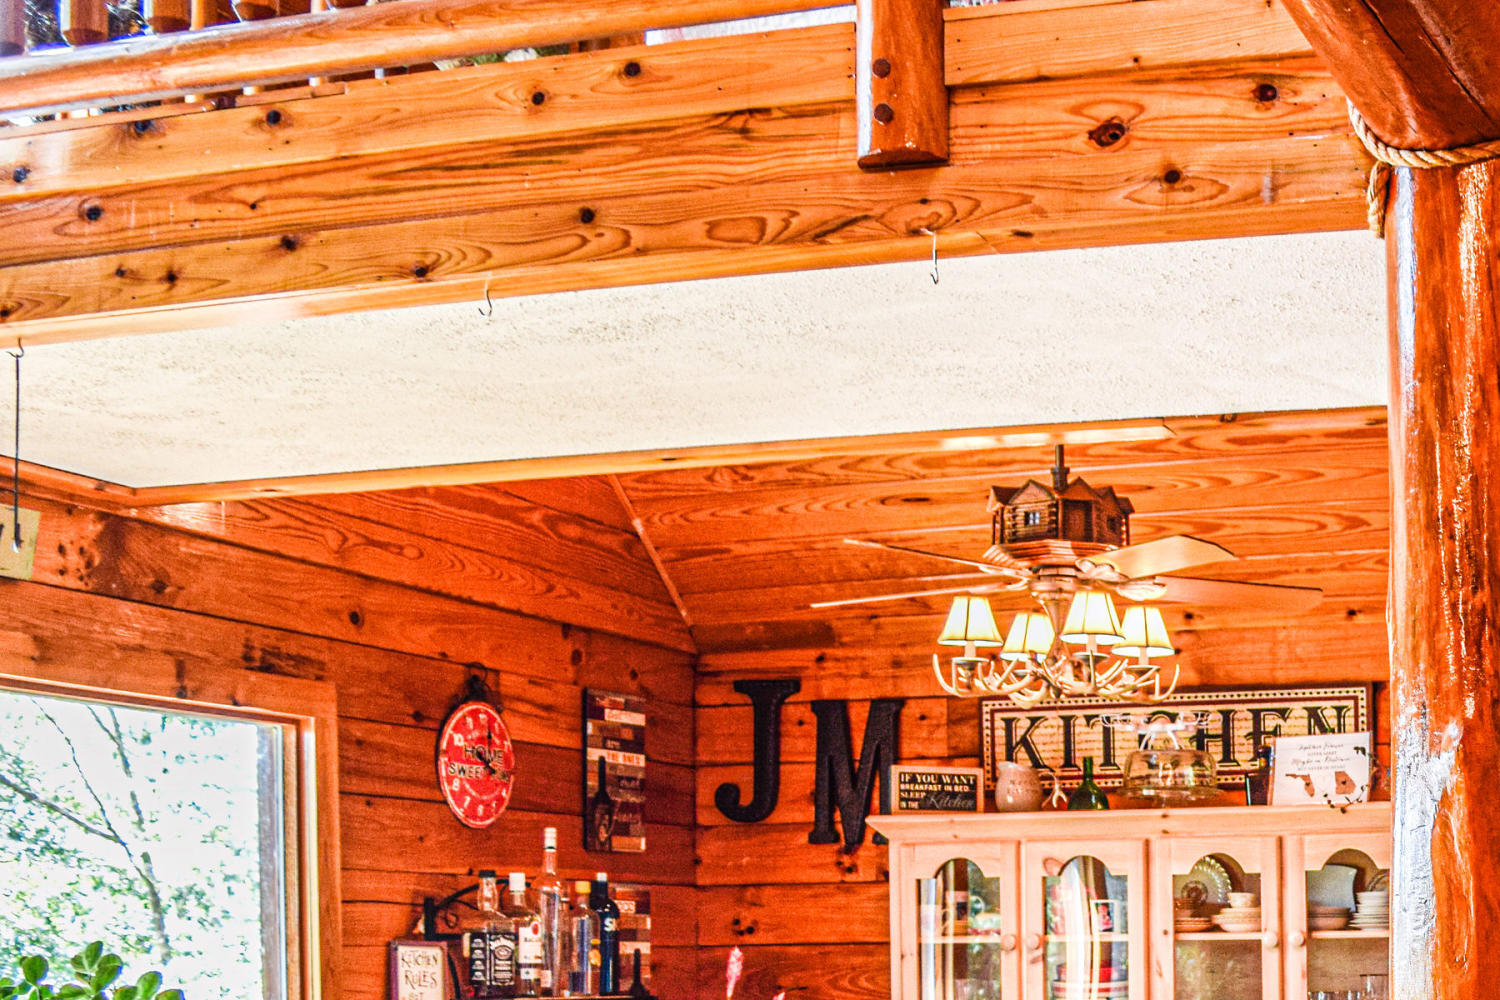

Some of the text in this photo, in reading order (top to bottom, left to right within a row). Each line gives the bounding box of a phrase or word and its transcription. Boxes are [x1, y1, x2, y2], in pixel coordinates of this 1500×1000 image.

[714, 679, 905, 853] J M
[900, 773, 976, 785] IF YOU WANT
[900, 783, 942, 792] BREAKFAST
[900, 791, 926, 799] SLEEP
[928, 792, 975, 810] Kitchen
[401, 950, 439, 969] KITCHEN
[404, 969, 438, 991] RULES
